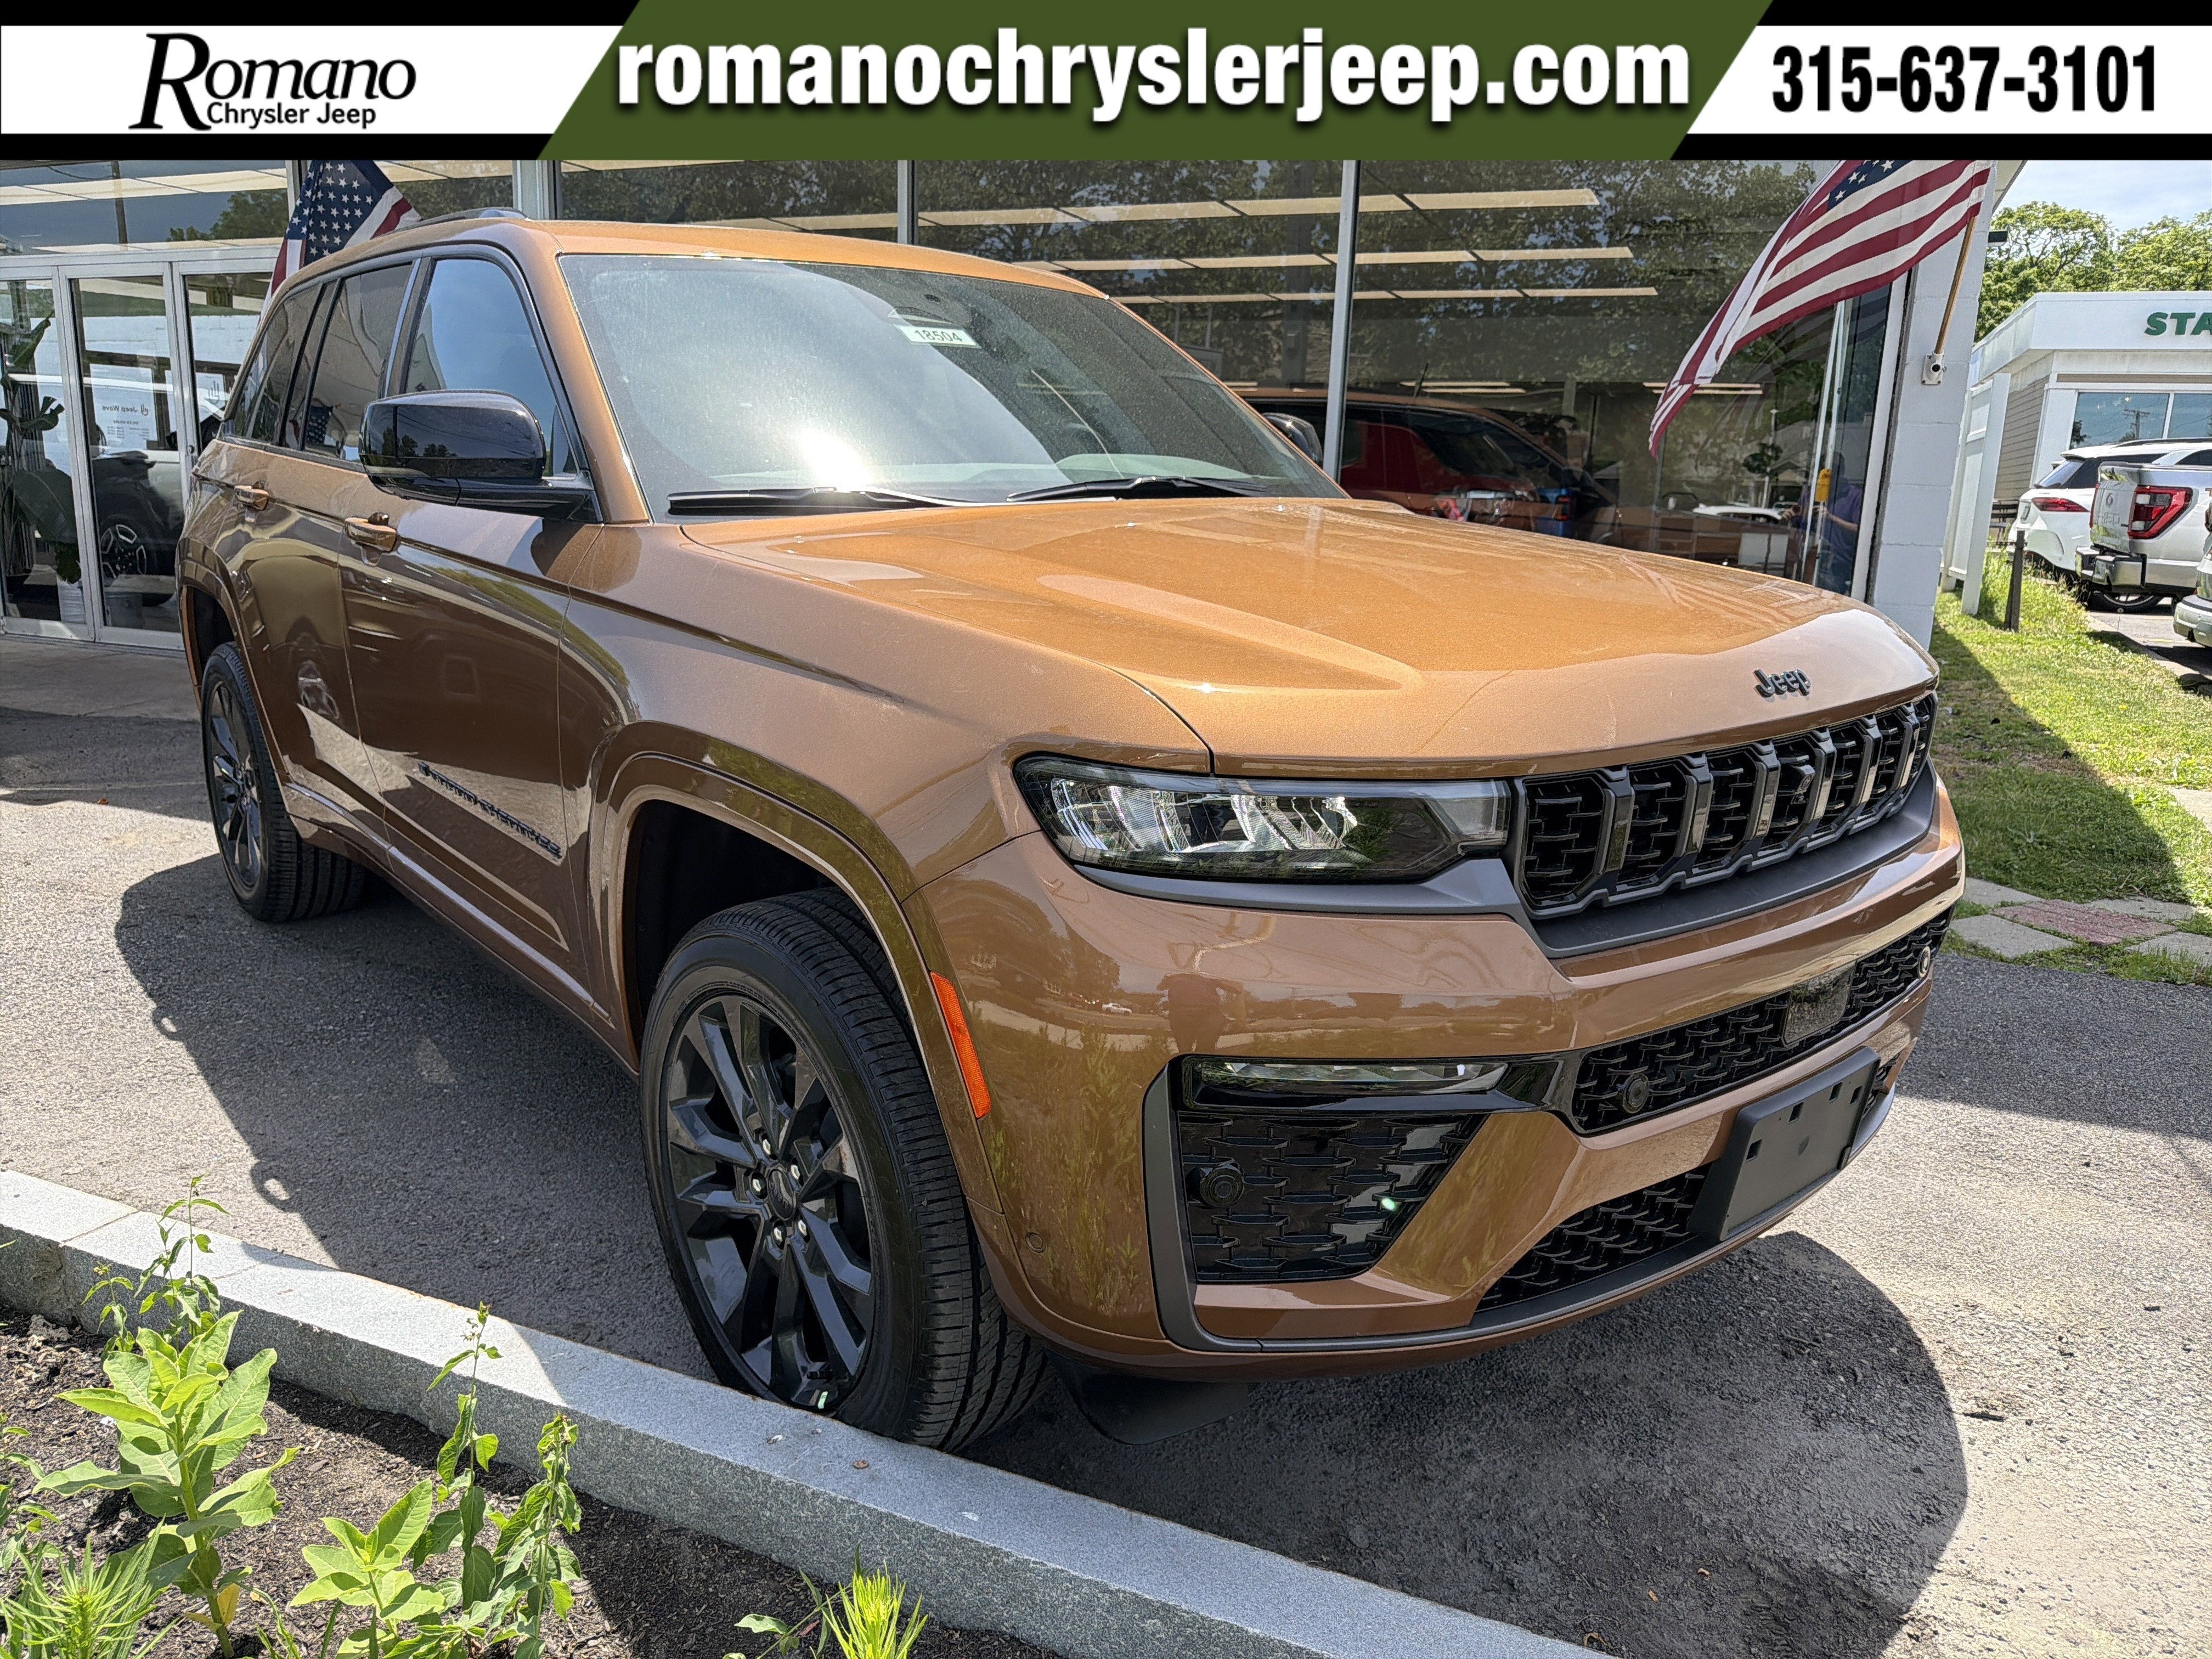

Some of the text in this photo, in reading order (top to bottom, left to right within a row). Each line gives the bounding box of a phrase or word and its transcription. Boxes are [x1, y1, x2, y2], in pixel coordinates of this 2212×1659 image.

[914, 329, 962, 342] 18504
[2144, 312, 2212, 336] STA
[1754, 669, 1811, 698] Jeep
